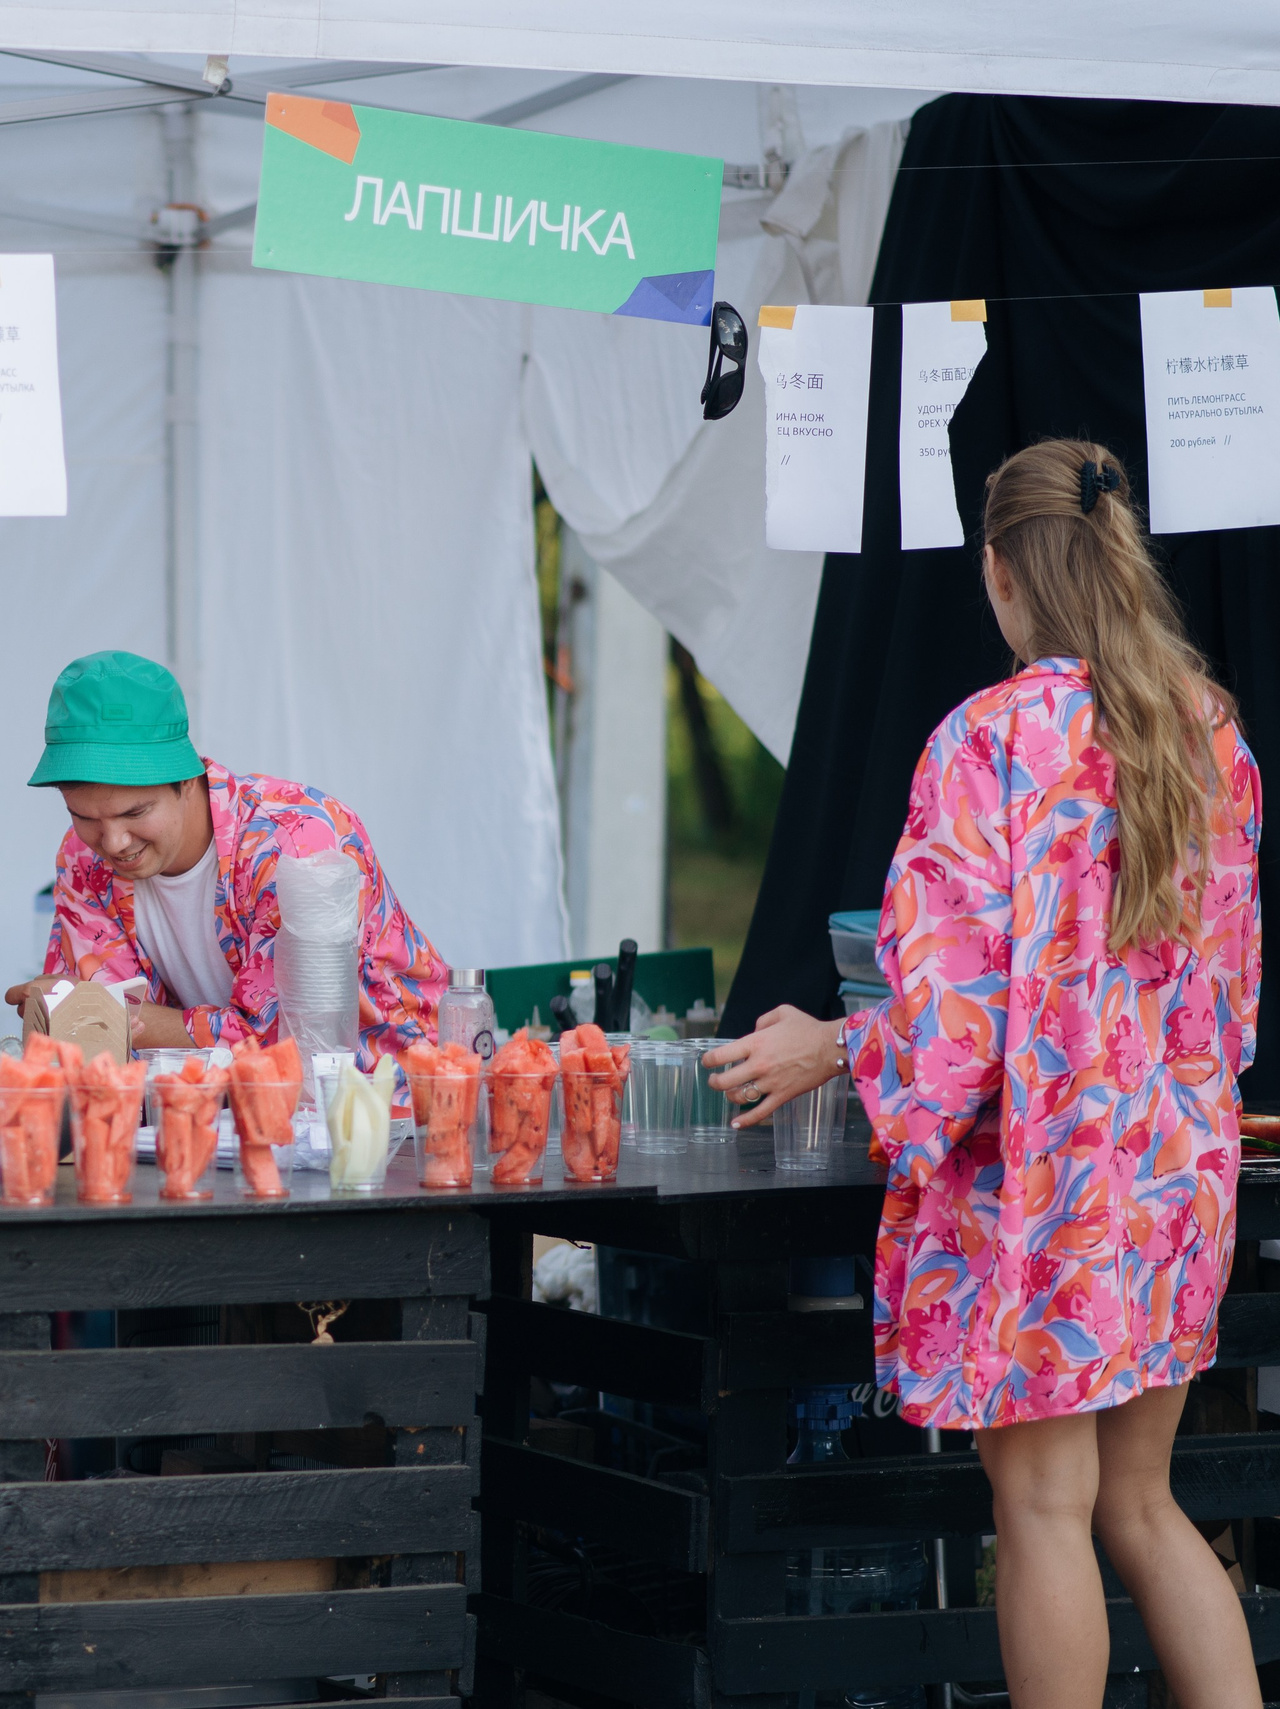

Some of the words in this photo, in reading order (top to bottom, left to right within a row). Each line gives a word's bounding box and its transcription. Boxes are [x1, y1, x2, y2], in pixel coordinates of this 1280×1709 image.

[344, 174, 635, 260] ЛАПШИЧКА
[1165, 353, 1250, 375] 柠檬水柠檬草
[1167, 396, 1190, 406] ПИТЬ
[1191, 392, 1246, 405] ЛЕМОНГРАСС
[917, 404, 943, 415] УДОН
[1168, 408, 1222, 420] НАТУРАЛЬНО
[1224, 405, 1264, 417] БУТЫЛКА
[799, 413, 825, 423] НОЖ
[918, 418, 941, 428] ОРЕХ
[792, 427, 834, 437] ВКУСНО
[1169, 438, 1186, 448] 200
[1187, 436, 1216, 449] рублей
[919, 447, 936, 457] 350
